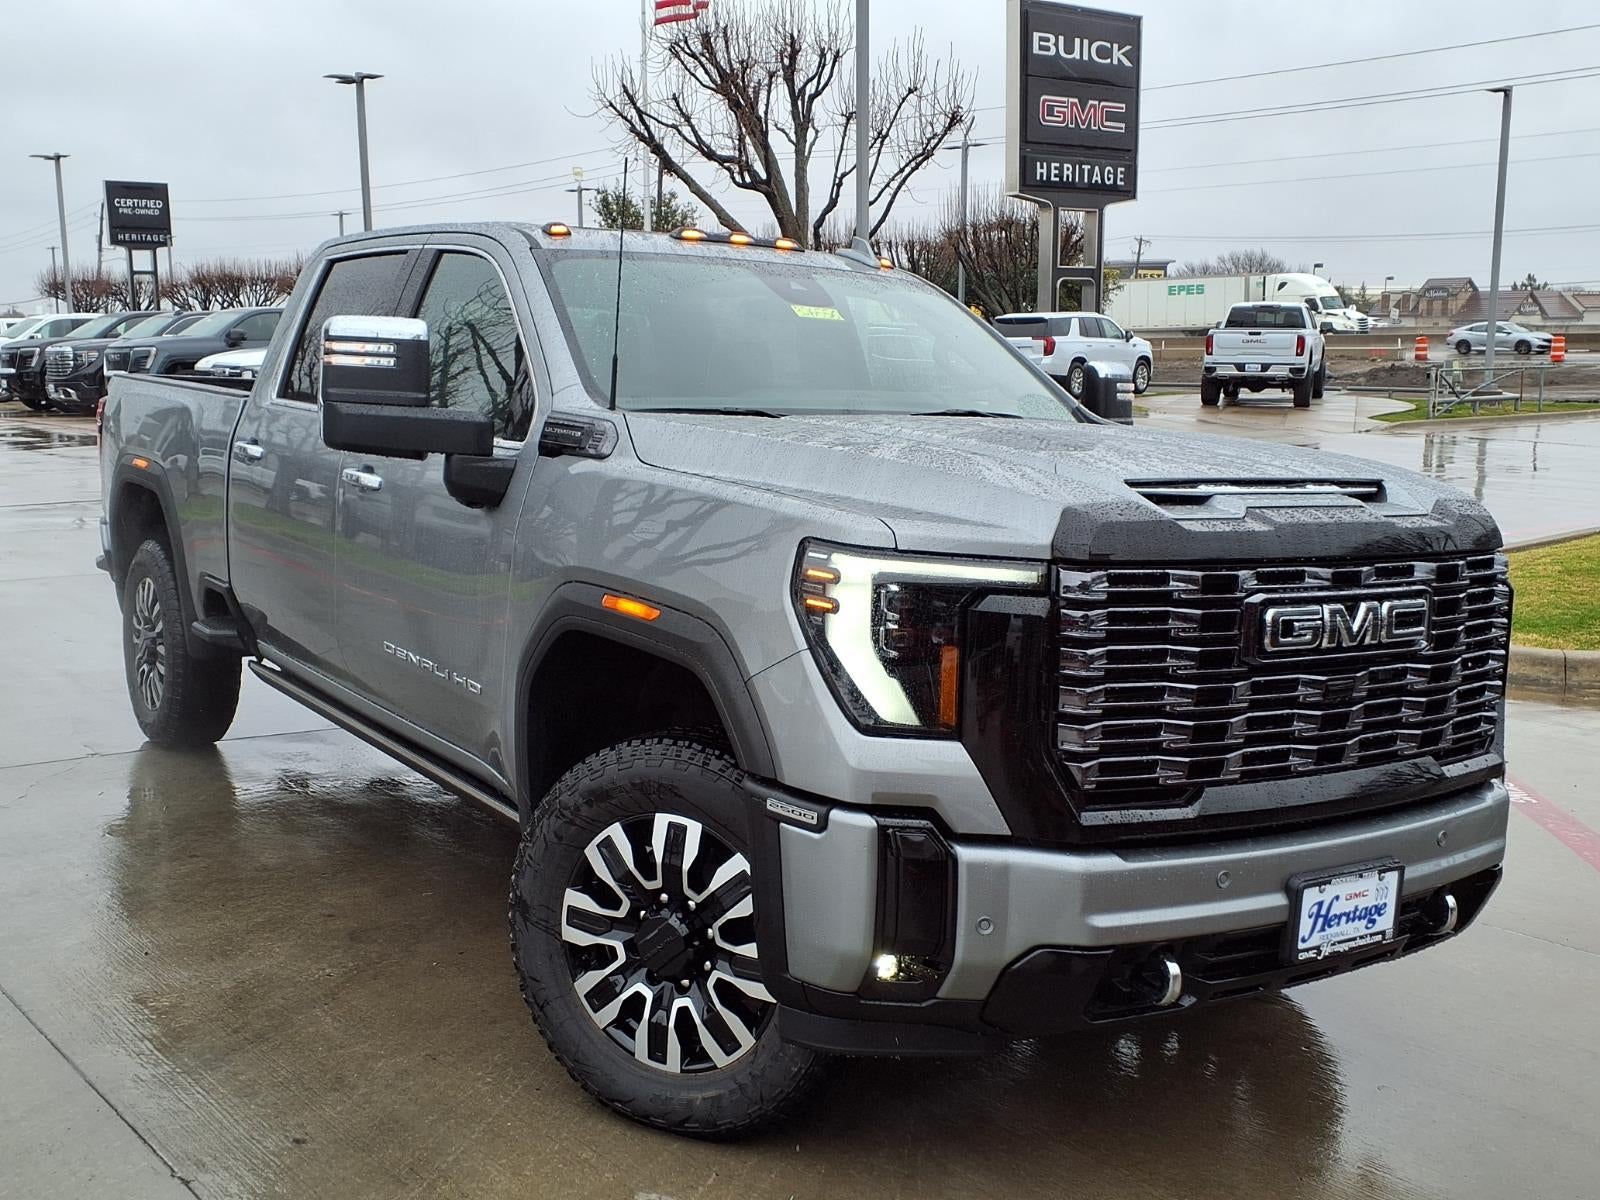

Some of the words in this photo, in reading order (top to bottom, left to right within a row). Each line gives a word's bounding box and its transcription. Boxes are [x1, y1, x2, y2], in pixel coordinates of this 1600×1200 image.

[1032, 31, 1133, 68] BUICK
[1039, 94, 1126, 133] GMC
[1036, 161, 1125, 185] HERITAGE
[114, 198, 163, 208] CERTIFIED
[118, 207, 160, 216] PRE-OWNED
[117, 233, 166, 242] HERITAGE
[1167, 284, 1205, 296] EPES
[1264, 599, 1428, 652] GMC
[383, 640, 449, 681] DENALI
[452, 672, 482, 696] HD
[768, 802, 815, 821] 2500
[1344, 889, 1370, 901] GMC
[1301, 894, 1388, 944] Heritage
